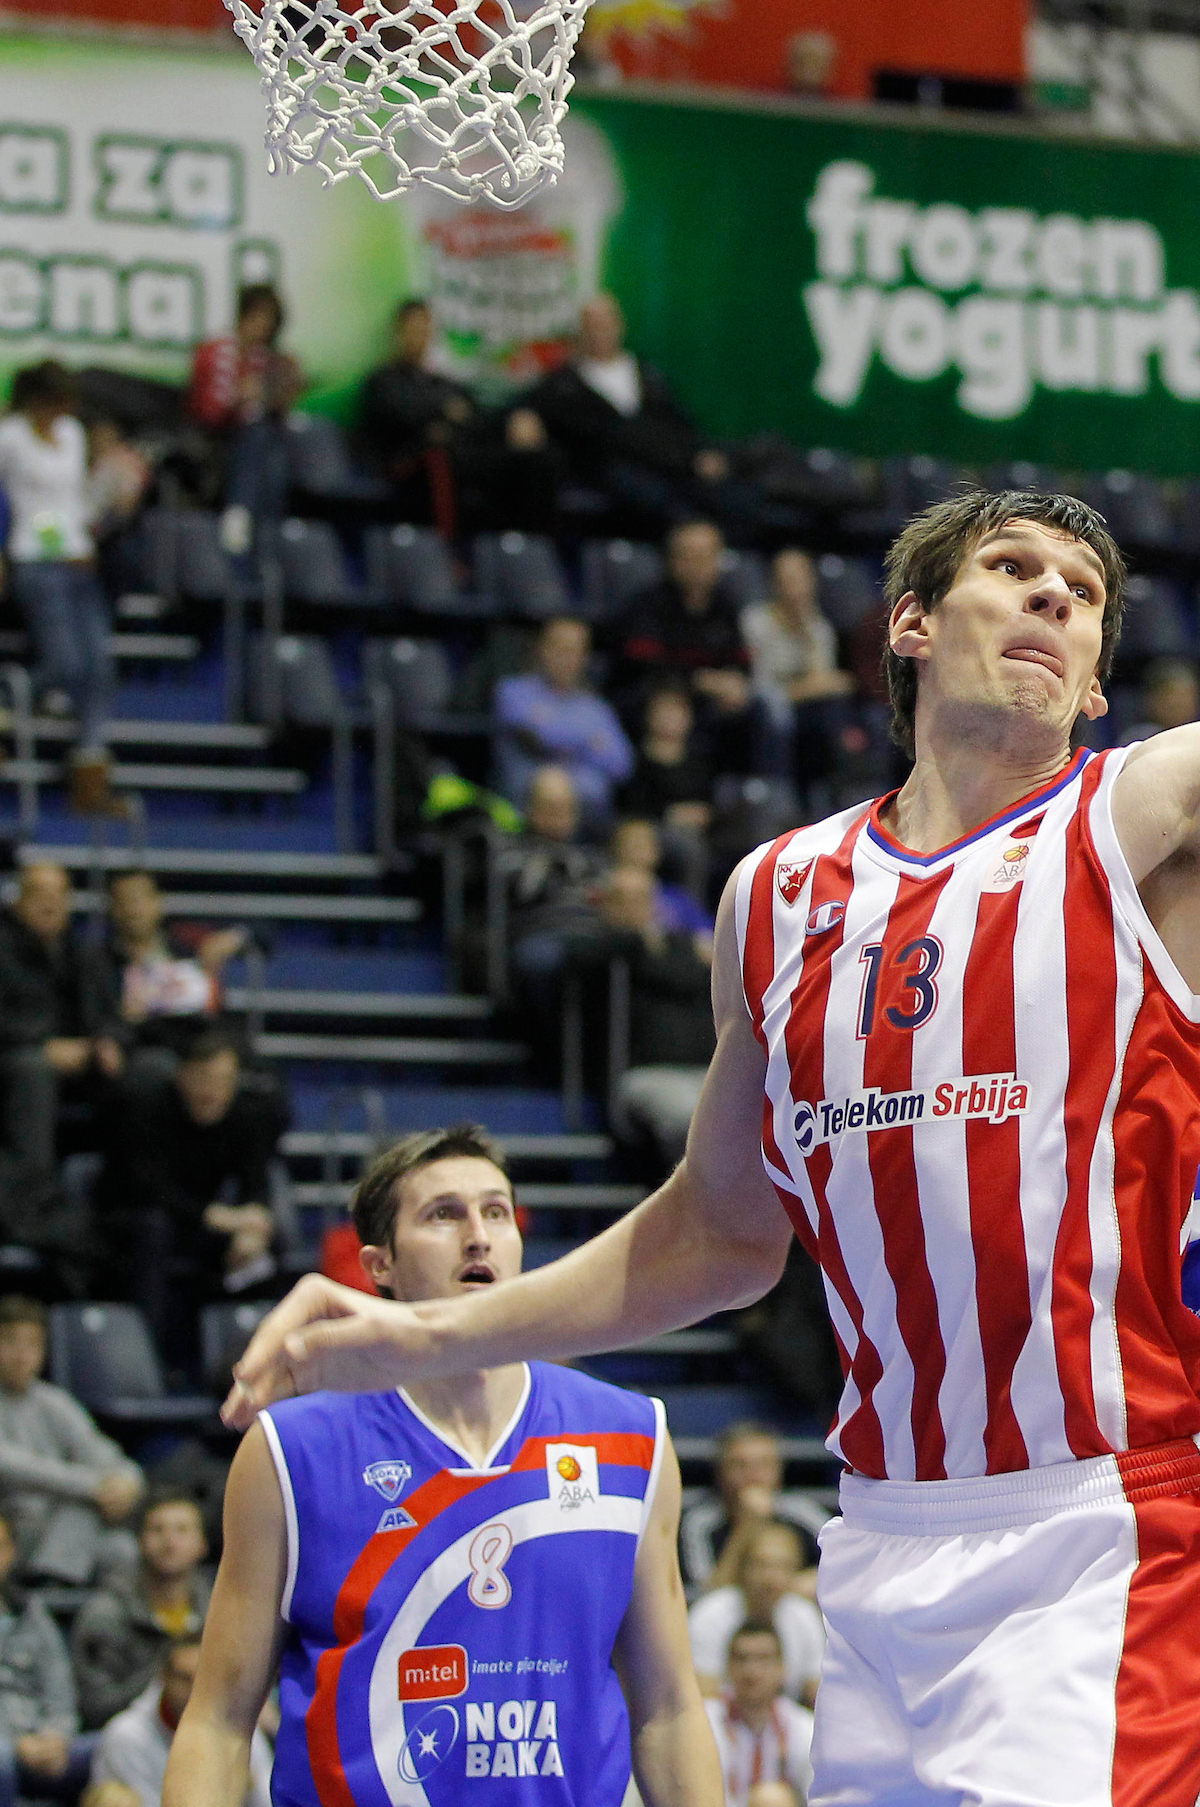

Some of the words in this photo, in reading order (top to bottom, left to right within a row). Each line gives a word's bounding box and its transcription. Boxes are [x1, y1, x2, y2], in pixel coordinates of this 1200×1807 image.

[98, 140, 237, 225] za
[805, 159, 1166, 301] frozen
[856, 933, 945, 1041] 13
[820, 1092, 925, 1138] Telekom
[932, 1079, 1028, 1119] Srbija
[558, 1485, 595, 1503] ABA
[468, 1523, 512, 1609] 8
[404, 1660, 459, 1684] m:tel
[472, 1659, 513, 1674] imate
